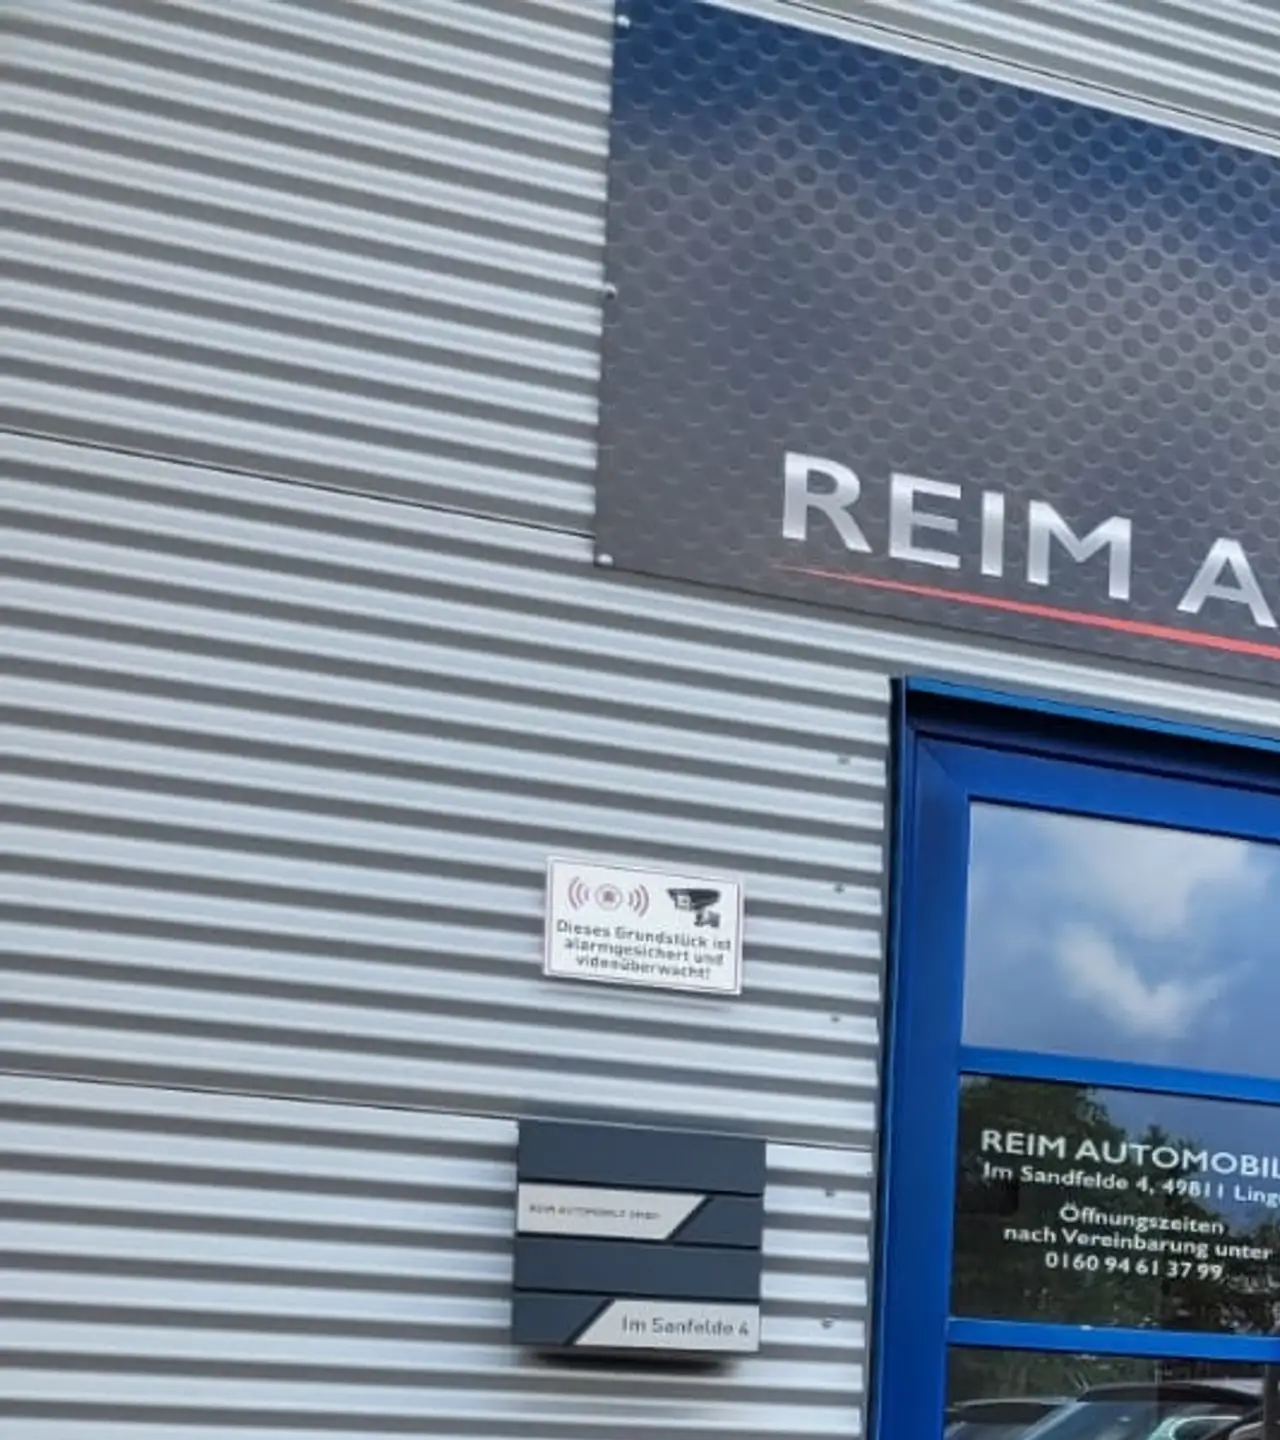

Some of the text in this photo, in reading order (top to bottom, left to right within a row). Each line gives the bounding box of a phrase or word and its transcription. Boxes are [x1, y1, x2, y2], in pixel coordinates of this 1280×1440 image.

[779, 451, 1134, 604] REIM
[556, 918, 732, 951] Dieses Grundstück ist
[564, 937, 724, 966] alarmgesichert und
[981, 1129, 1066, 1160] REIM
[982, 1162, 1012, 1180] Im
[1020, 1164, 1129, 1192] Sandfelde
[1136, 1178, 1156, 1196] 4,
[1161, 1179, 1224, 1200] 49811
[1060, 1200, 1225, 1236] Öffnungszeiten
[1004, 1224, 1274, 1261] nach Vereinbarung unter
[1045, 1251, 1224, 1281] 0160 94 61 37 99
[621, 1314, 750, 1337] Im Sanfelde 4
